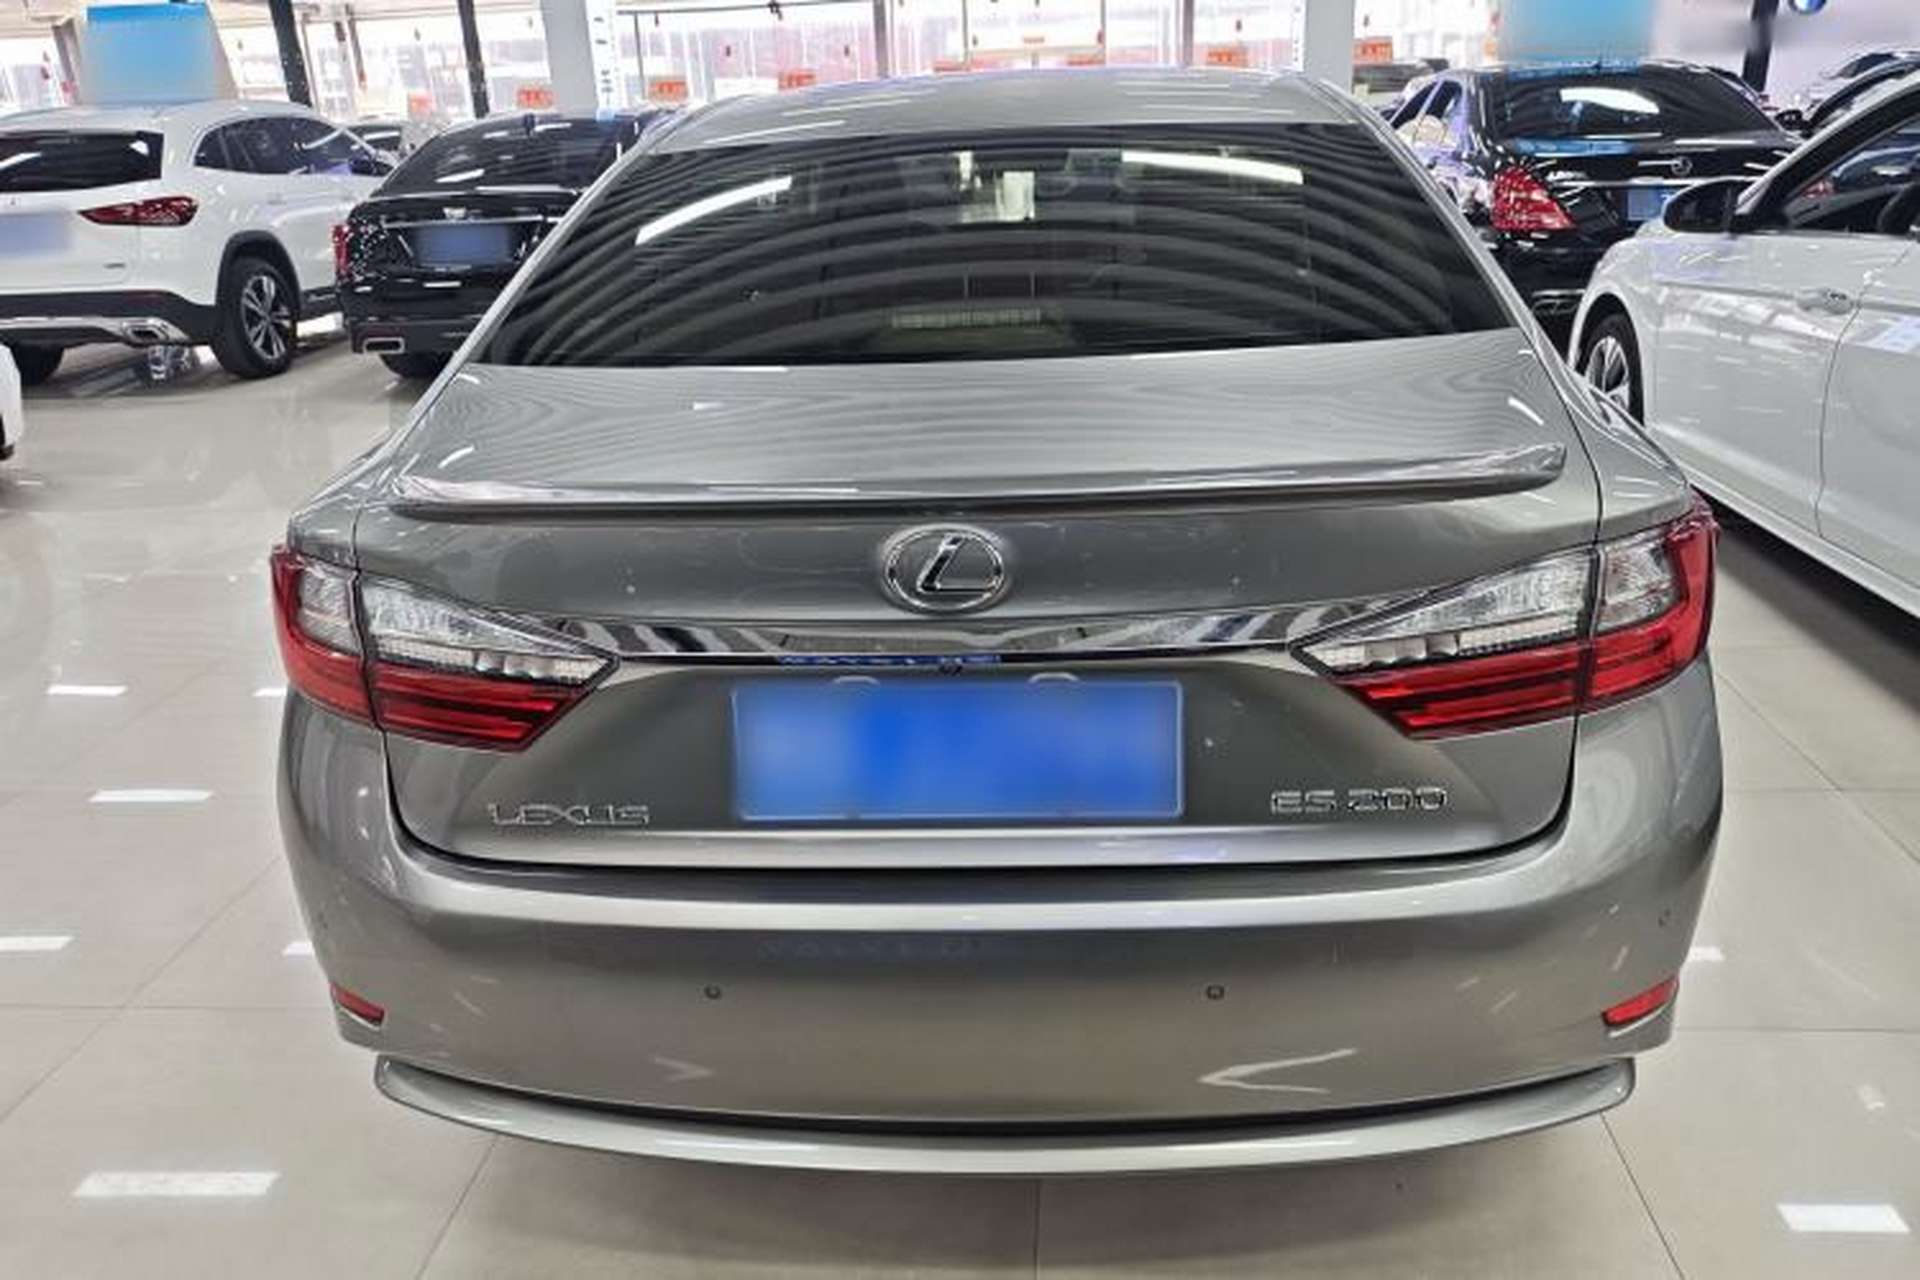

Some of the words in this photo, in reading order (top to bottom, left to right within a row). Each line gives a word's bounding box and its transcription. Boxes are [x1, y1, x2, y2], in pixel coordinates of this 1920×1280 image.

[1271, 789, 1337, 813] ES
[1348, 786, 1448, 812] 200
[488, 803, 649, 826] LEXUS
